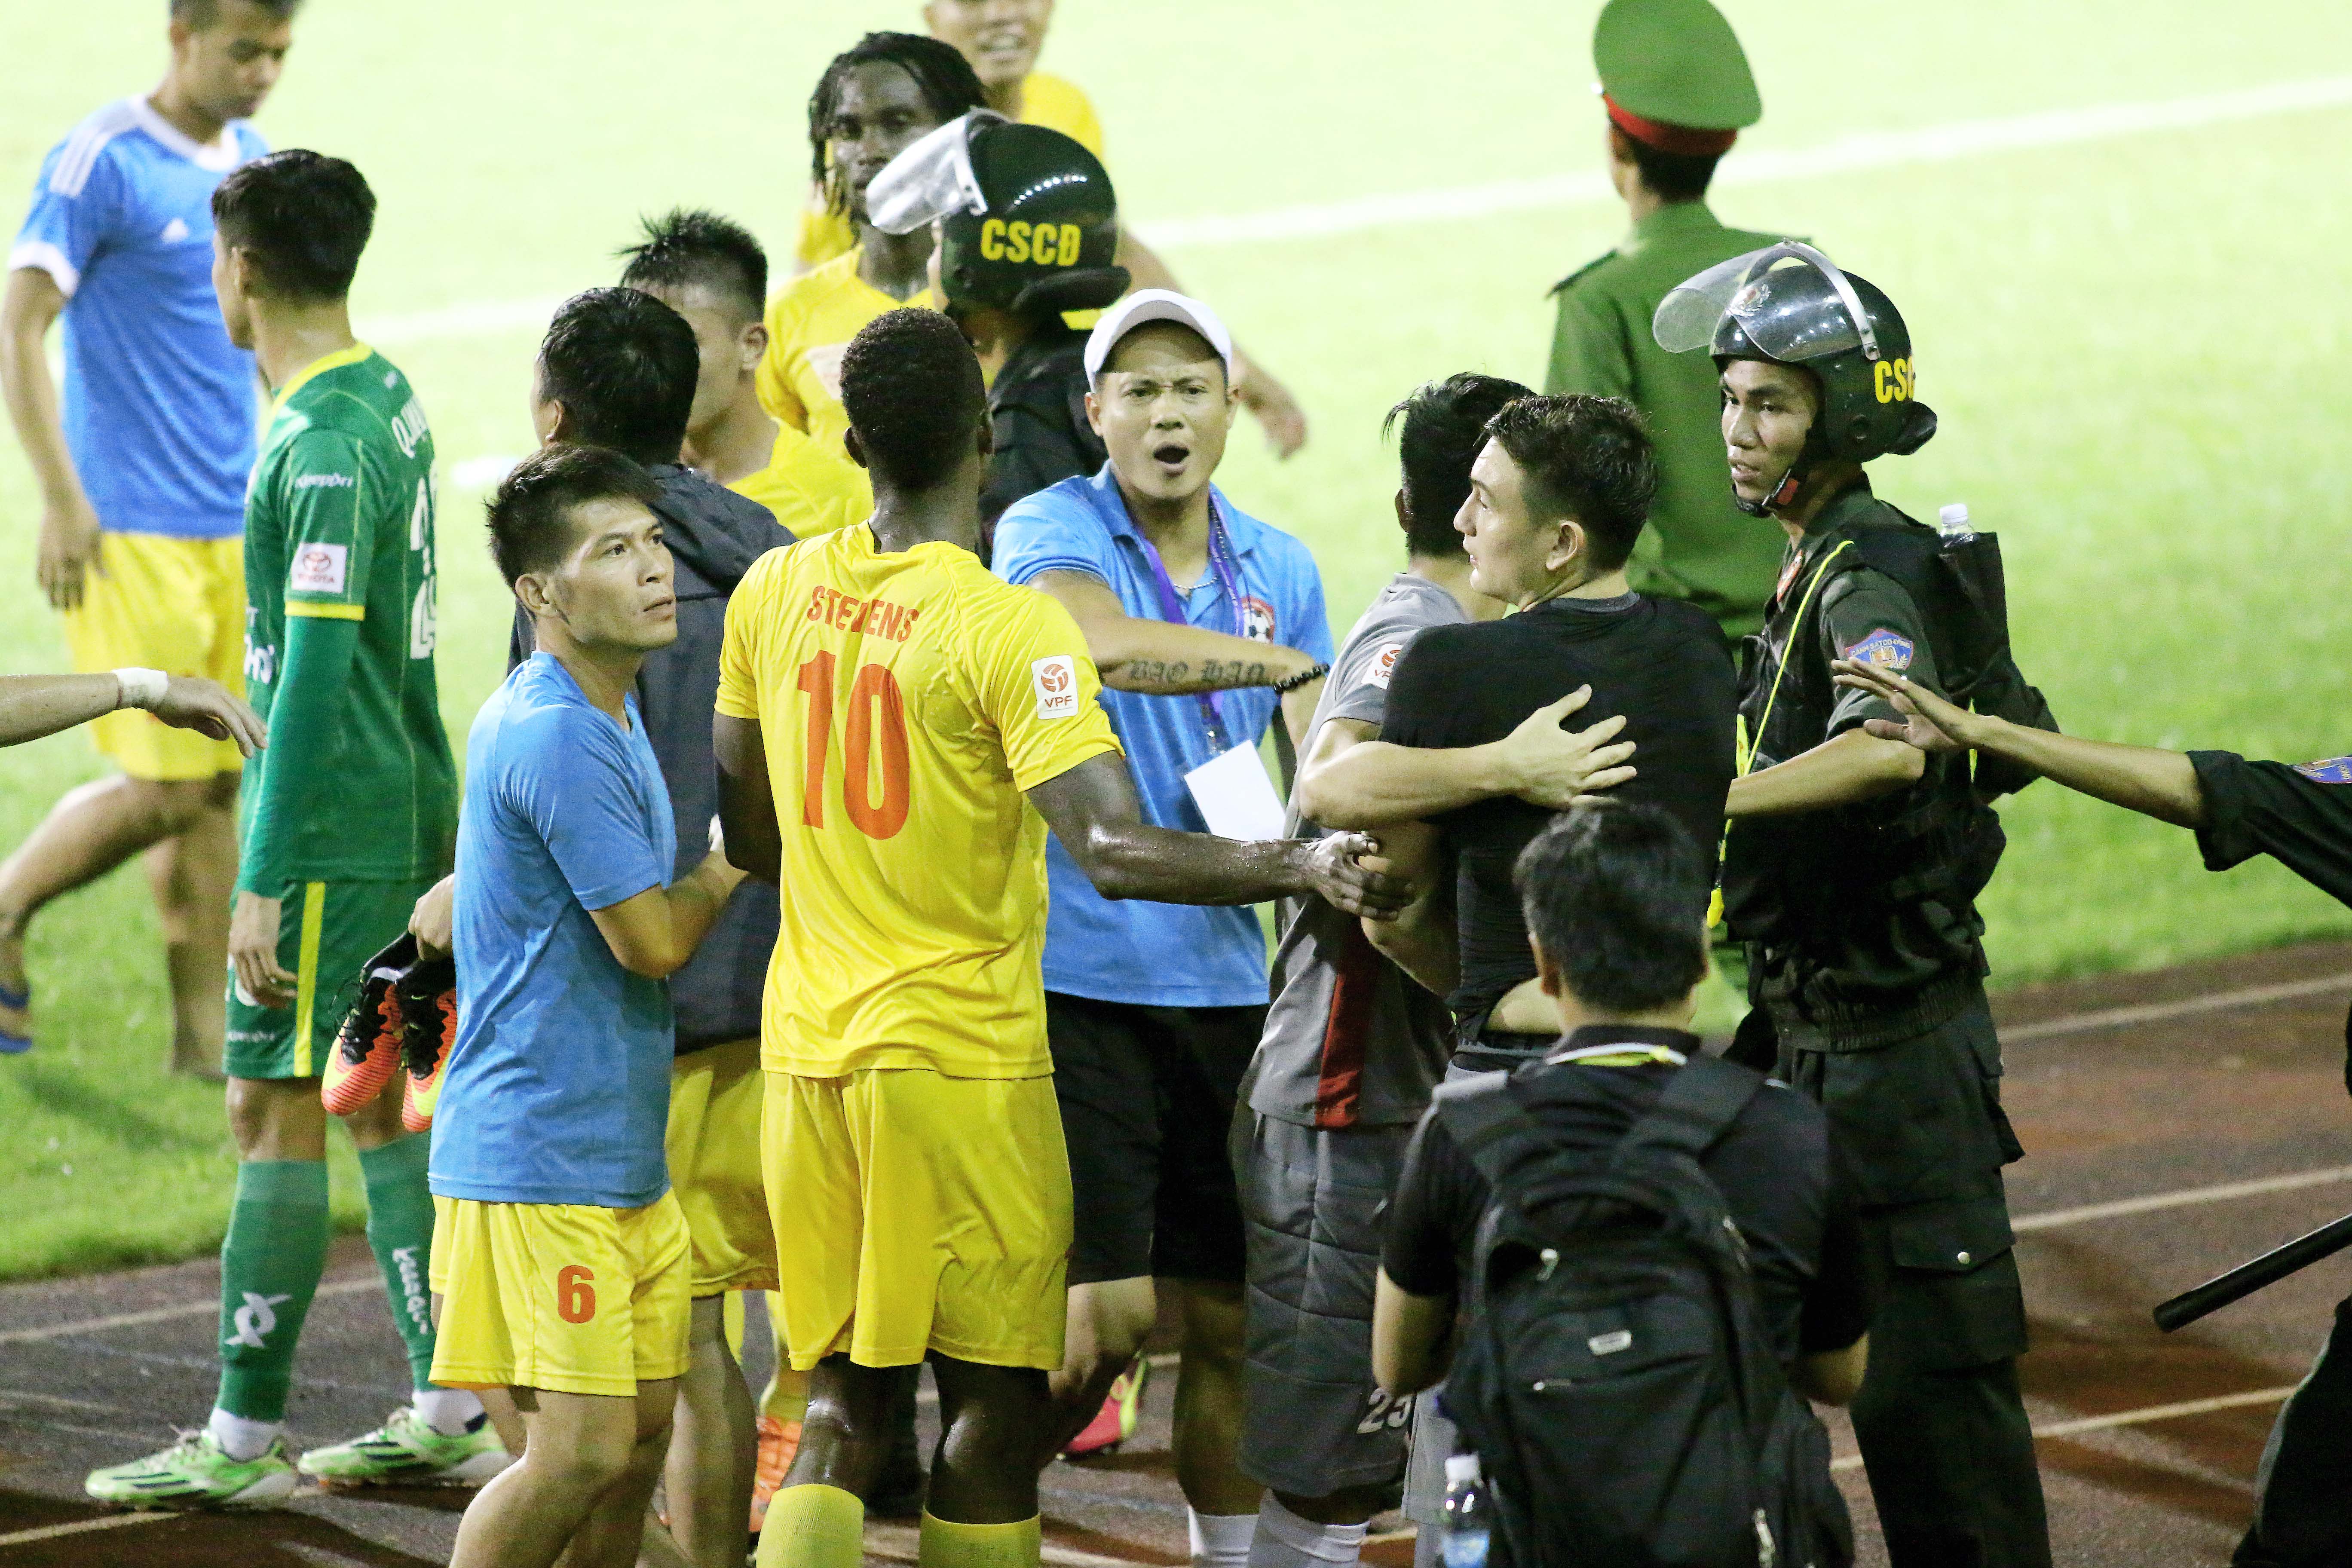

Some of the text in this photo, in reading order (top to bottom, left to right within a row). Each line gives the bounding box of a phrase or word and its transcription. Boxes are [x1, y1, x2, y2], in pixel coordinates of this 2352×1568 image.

[1044, 695, 1072, 708] VPF
[797, 649, 910, 839] 10
[557, 1265, 596, 1324] 6
